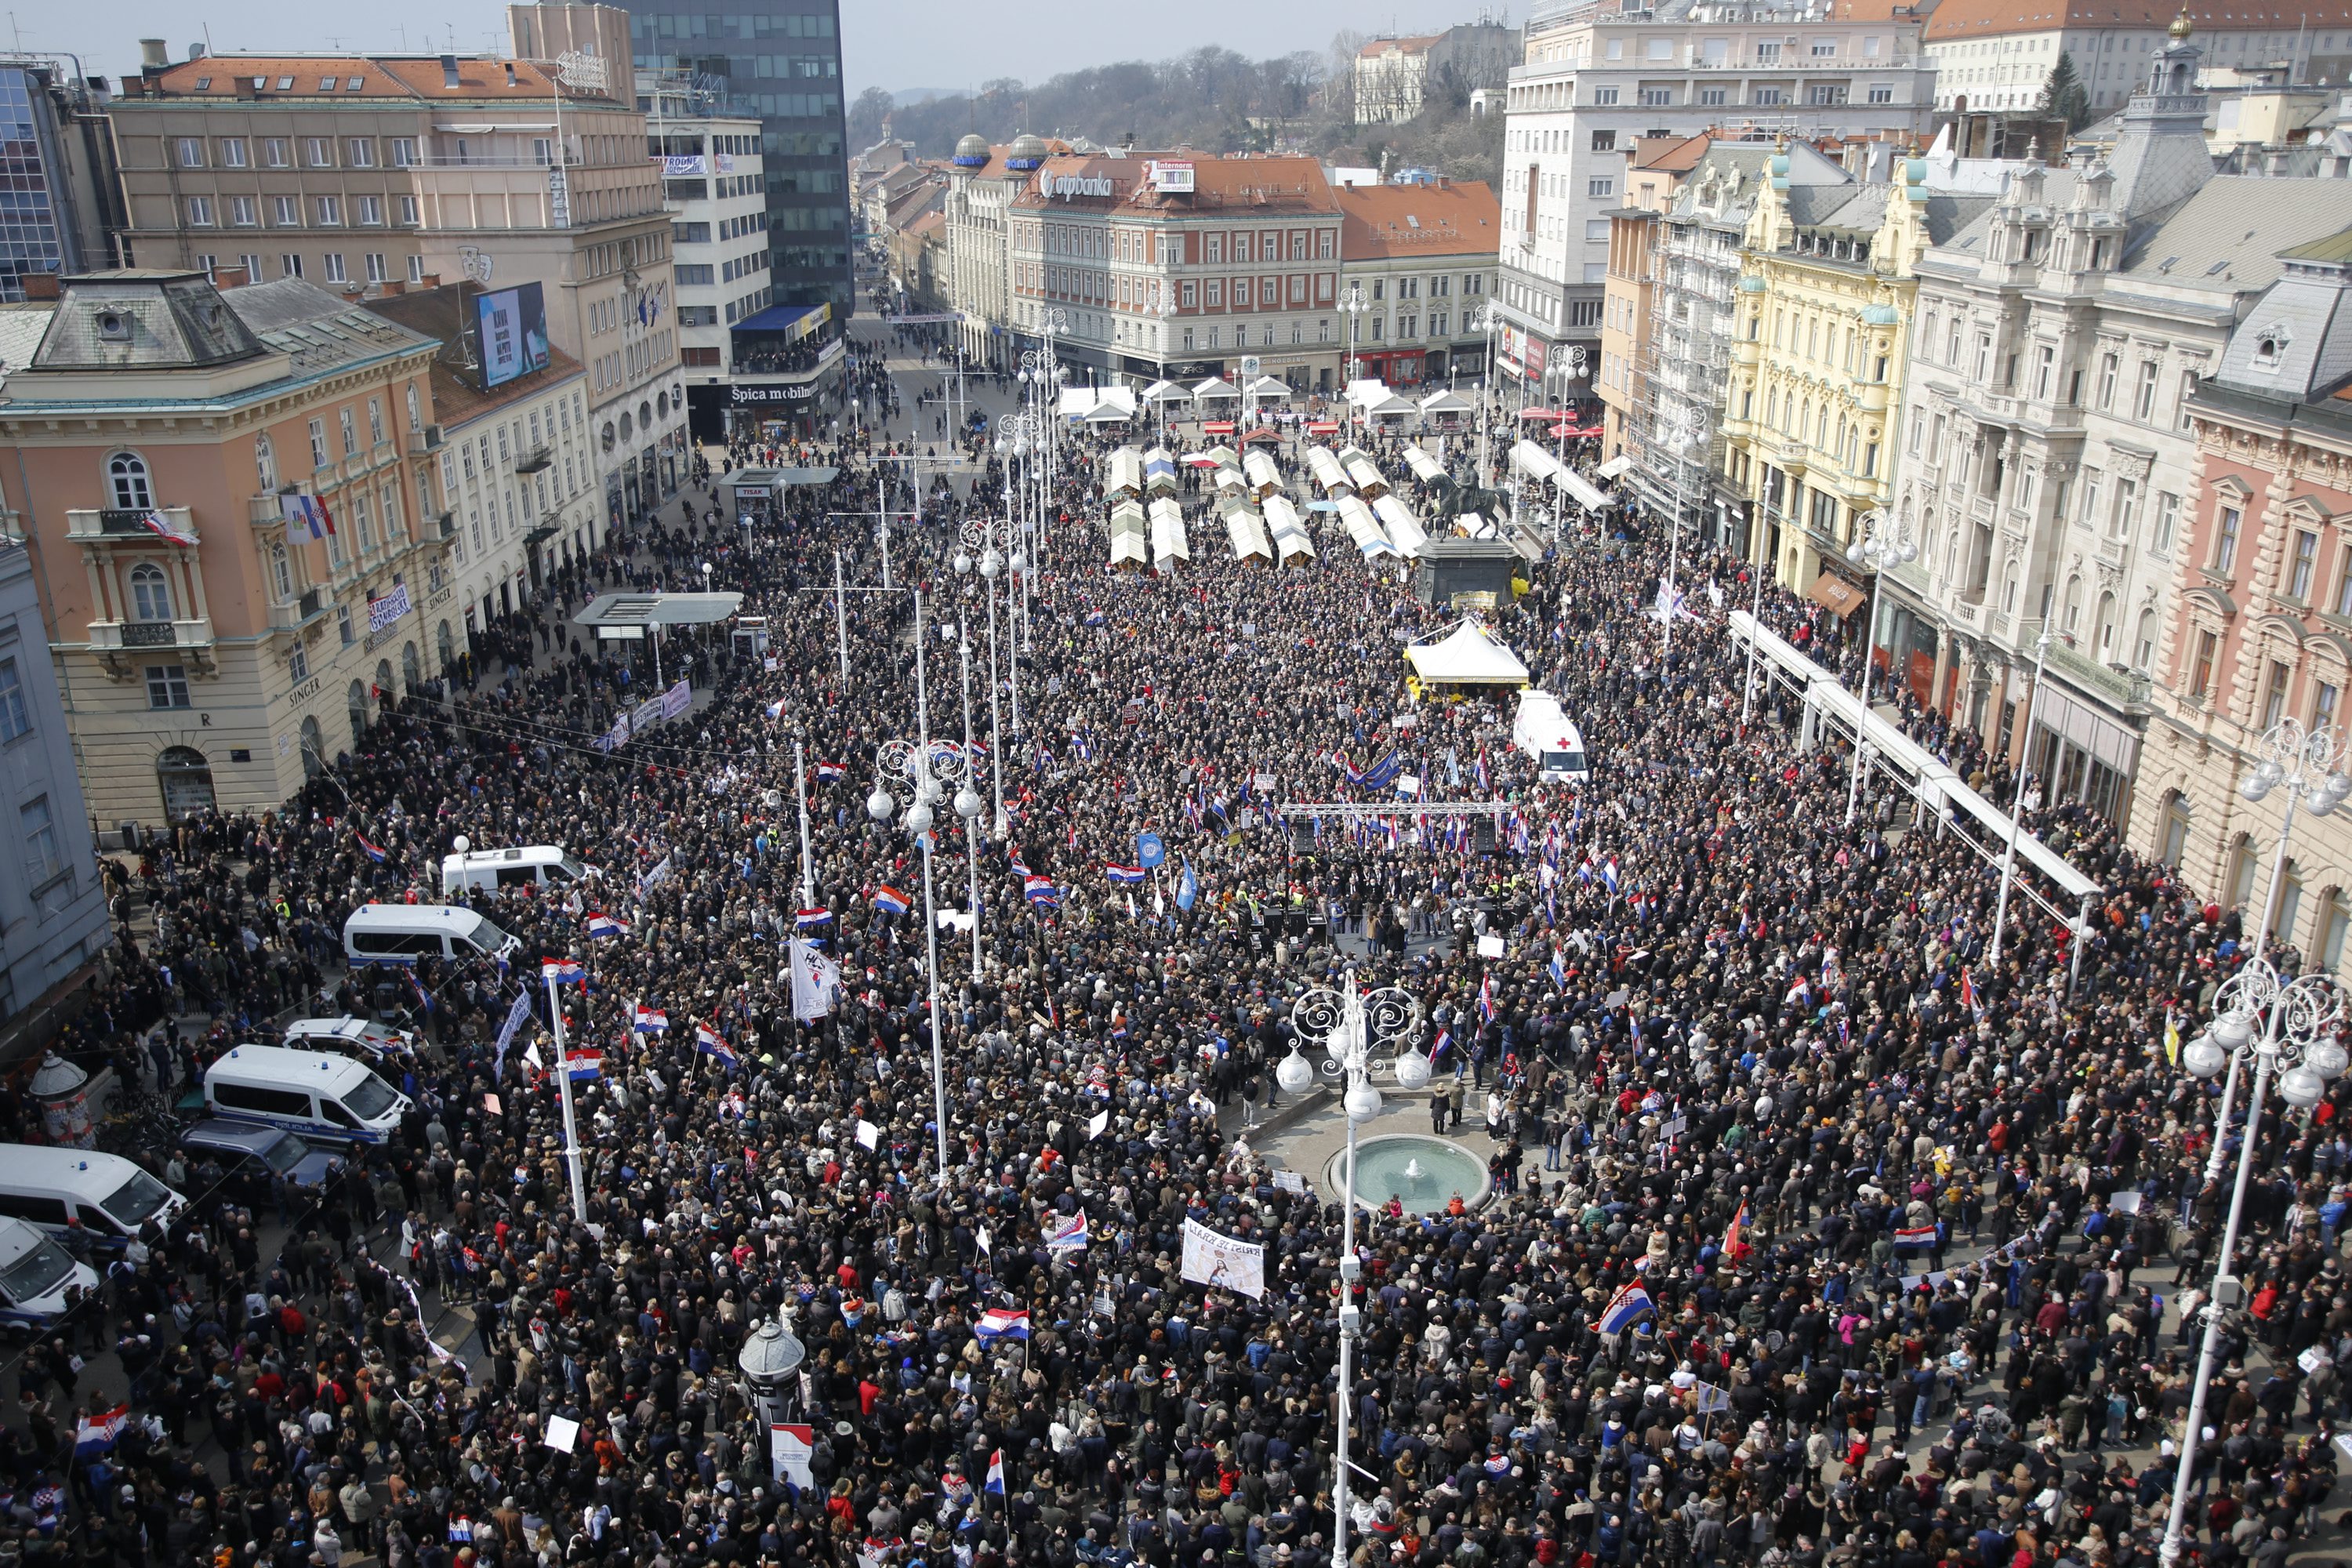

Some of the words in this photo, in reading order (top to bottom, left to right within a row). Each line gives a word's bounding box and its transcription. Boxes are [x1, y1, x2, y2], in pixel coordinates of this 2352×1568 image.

[670, 158, 696, 166] RODNE
[1056, 170, 1112, 201] otpbanka
[732, 385, 767, 403] Špica
[770, 386, 813, 401] mobiln
[429, 587, 451, 610] SINGER
[289, 677, 321, 708] SINGER
[275, 1121, 313, 1132] POLICIJA
